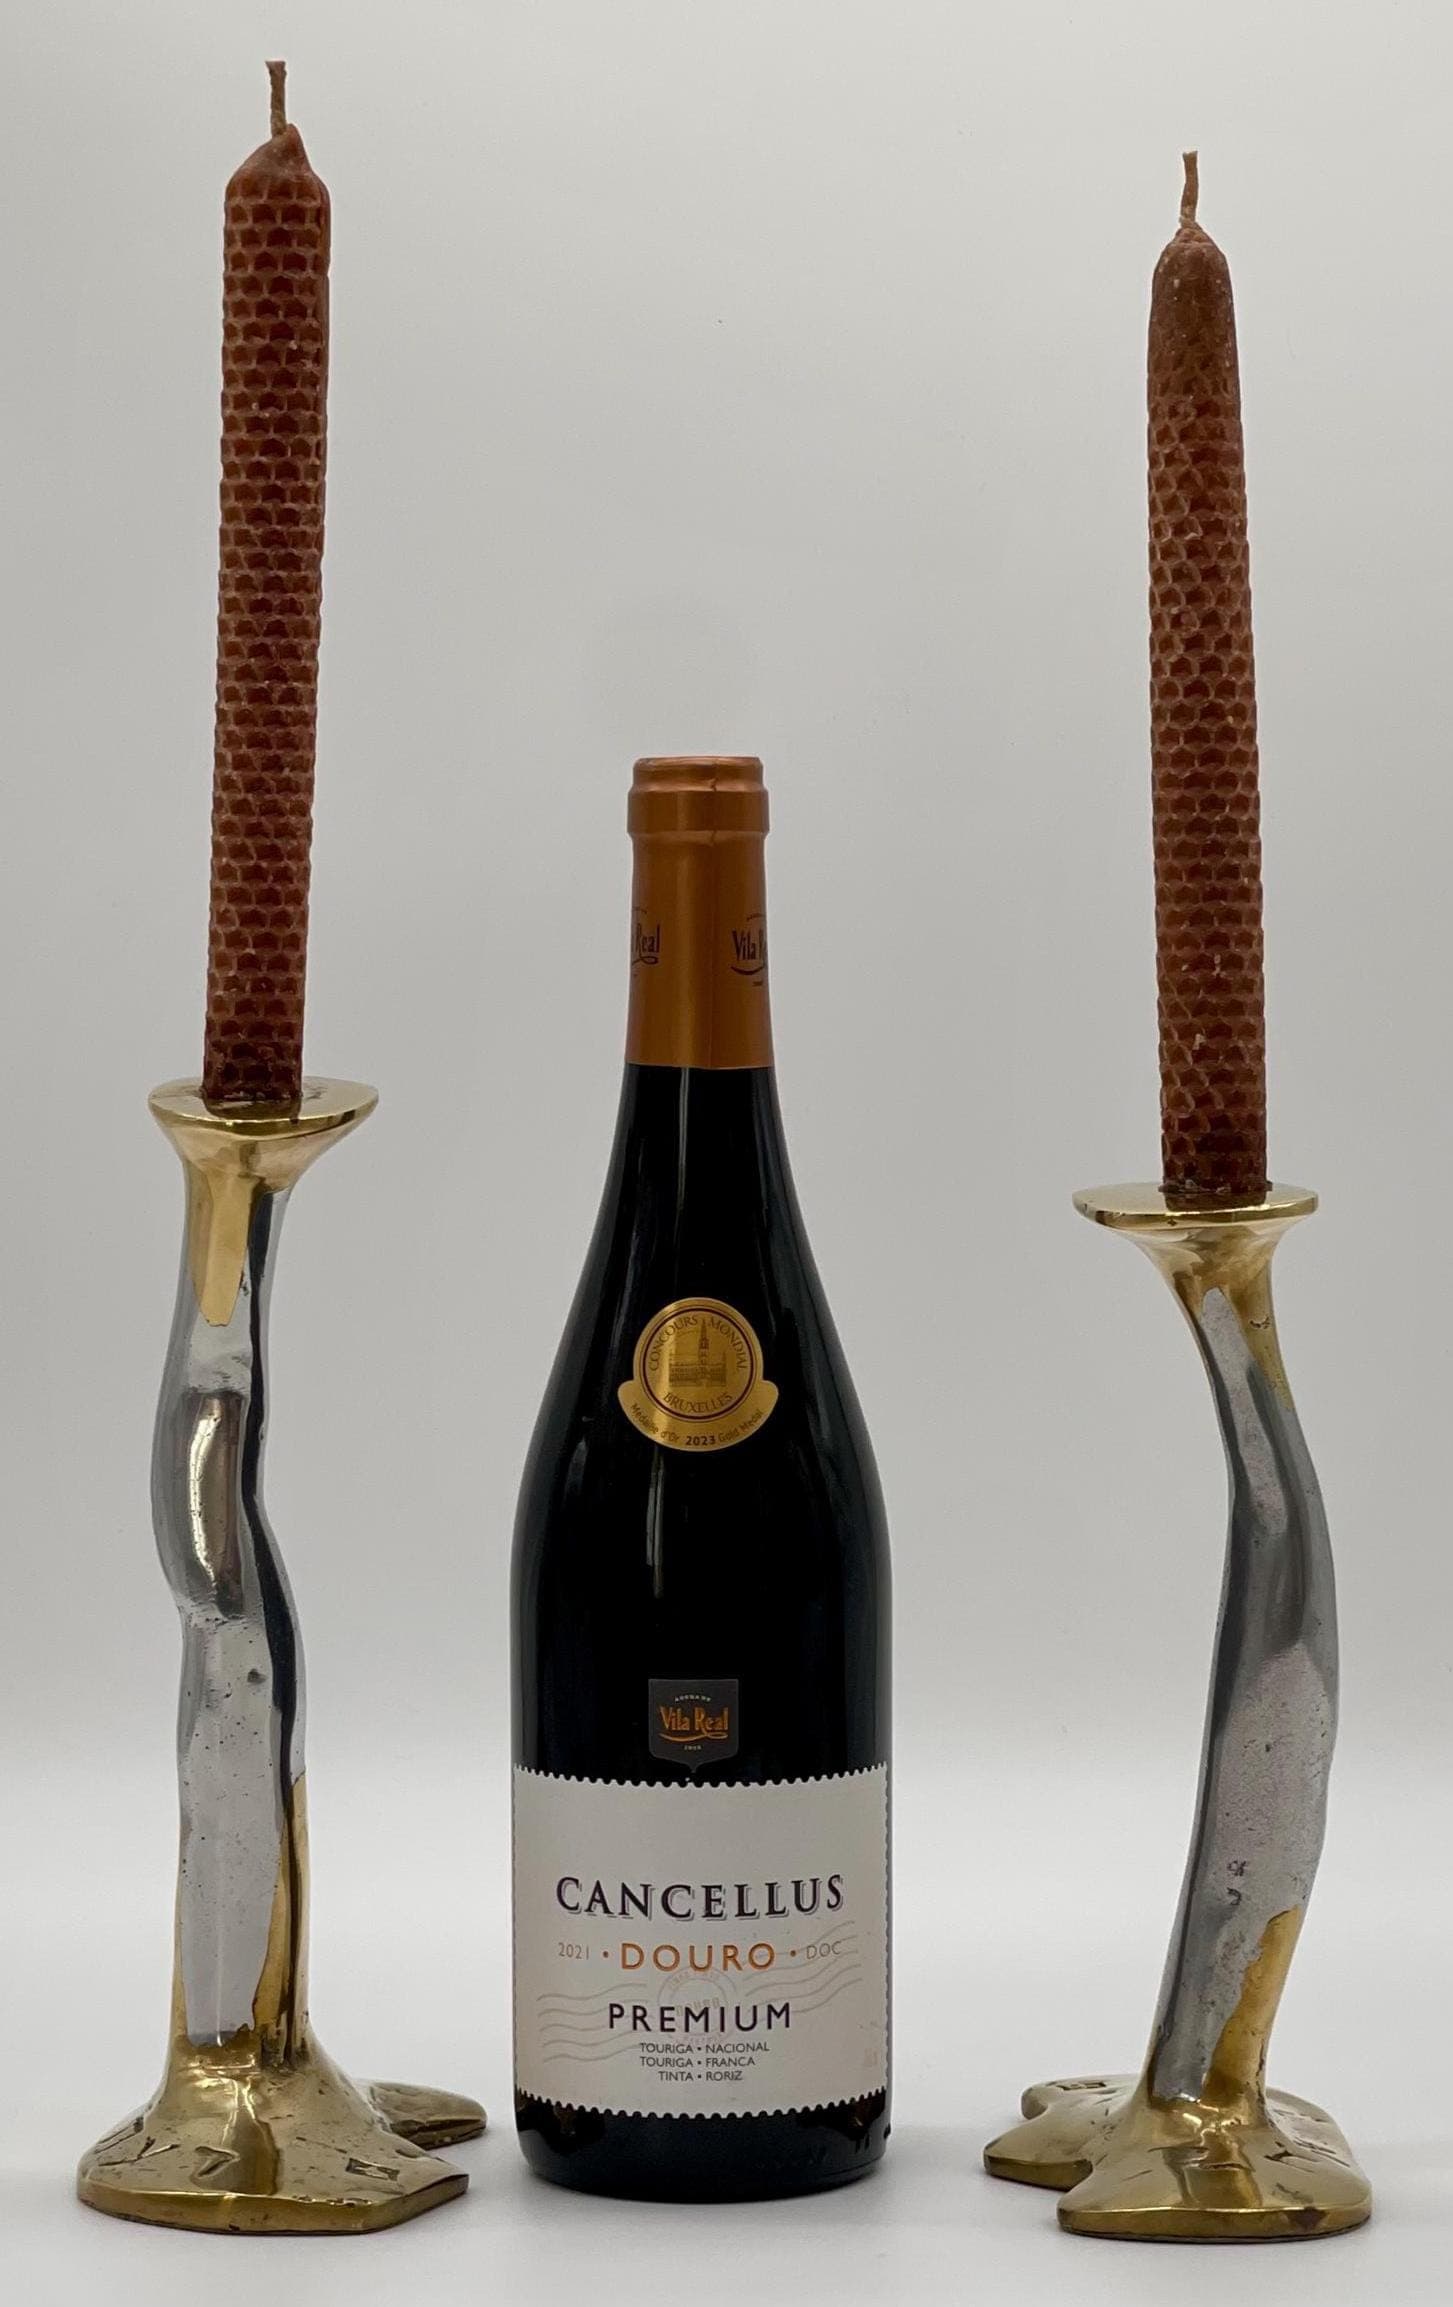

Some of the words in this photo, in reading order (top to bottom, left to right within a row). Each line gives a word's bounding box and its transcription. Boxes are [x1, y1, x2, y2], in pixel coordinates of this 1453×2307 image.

[649, 1315, 698, 1371] CONCOURS
[663, 1391, 734, 1414] BRUXELLES
[685, 1434, 716, 1447] 2023
[718, 1427, 741, 1444] Gold
[659, 1706, 690, 1731] Vila
[694, 1706, 729, 1735] Real
[556, 1874, 844, 1921] CANCELLUS
[557, 1942, 590, 1961] 2021
[621, 1942, 776, 1972] DOURO
[805, 1940, 843, 1961] DOC
[608, 2002, 790, 2033] PREMIUM
[639, 2043, 694, 2054] TOURIGA
[705, 2042, 770, 2054] NACIONAL
[639, 2056, 694, 2068] TOURIGA
[658, 2071, 694, 2082] TINTA
[705, 2071, 743, 2082] RORIZ
